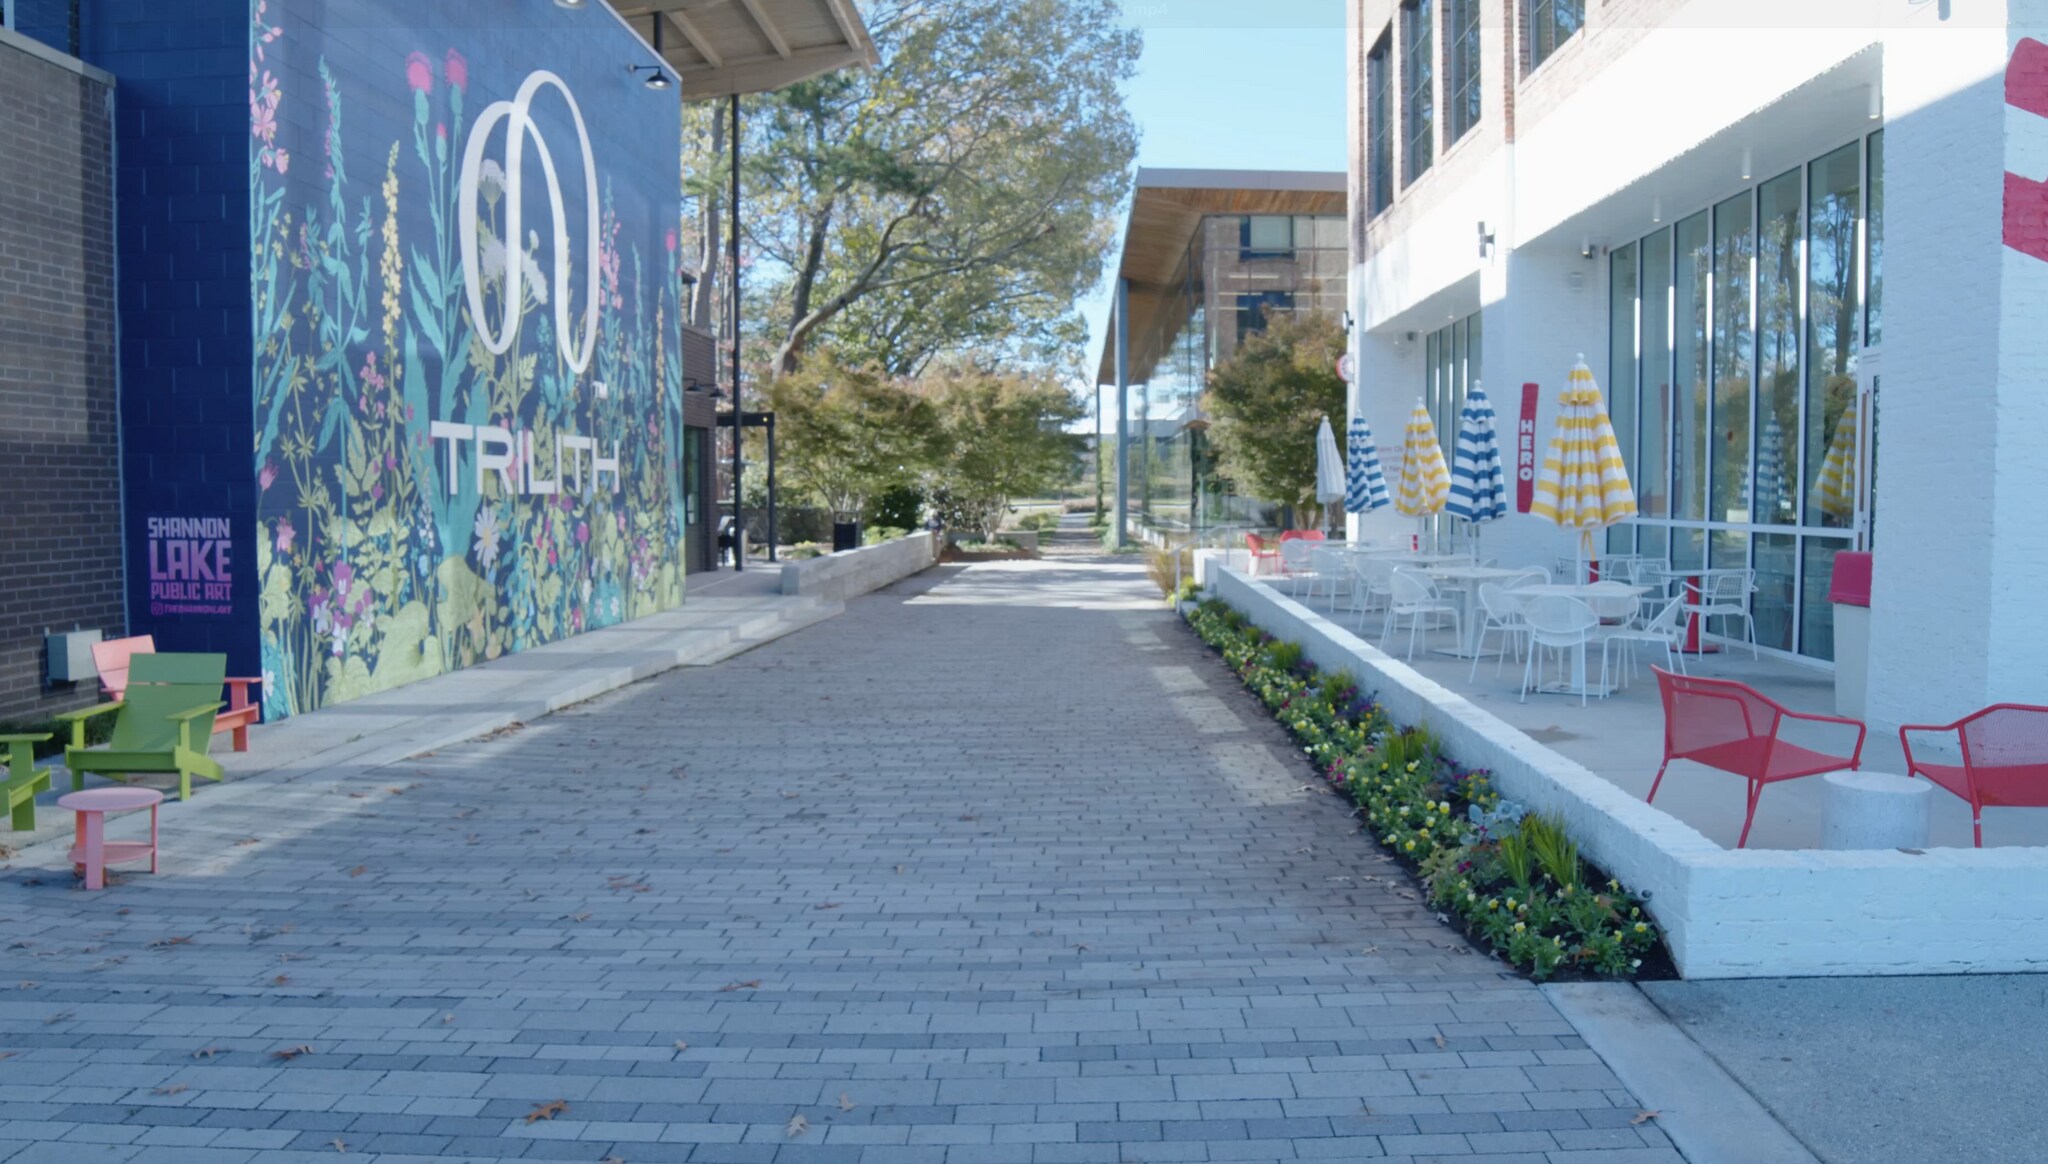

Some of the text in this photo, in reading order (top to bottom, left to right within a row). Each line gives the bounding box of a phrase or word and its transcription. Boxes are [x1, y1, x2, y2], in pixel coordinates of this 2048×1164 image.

[431, 420, 620, 495] TRILITH
[1519, 419, 1534, 481] HERO
[148, 517, 230, 539] SHANNON
[150, 540, 232, 582] LAKE
[151, 582, 232, 602] PUBLIC ART
